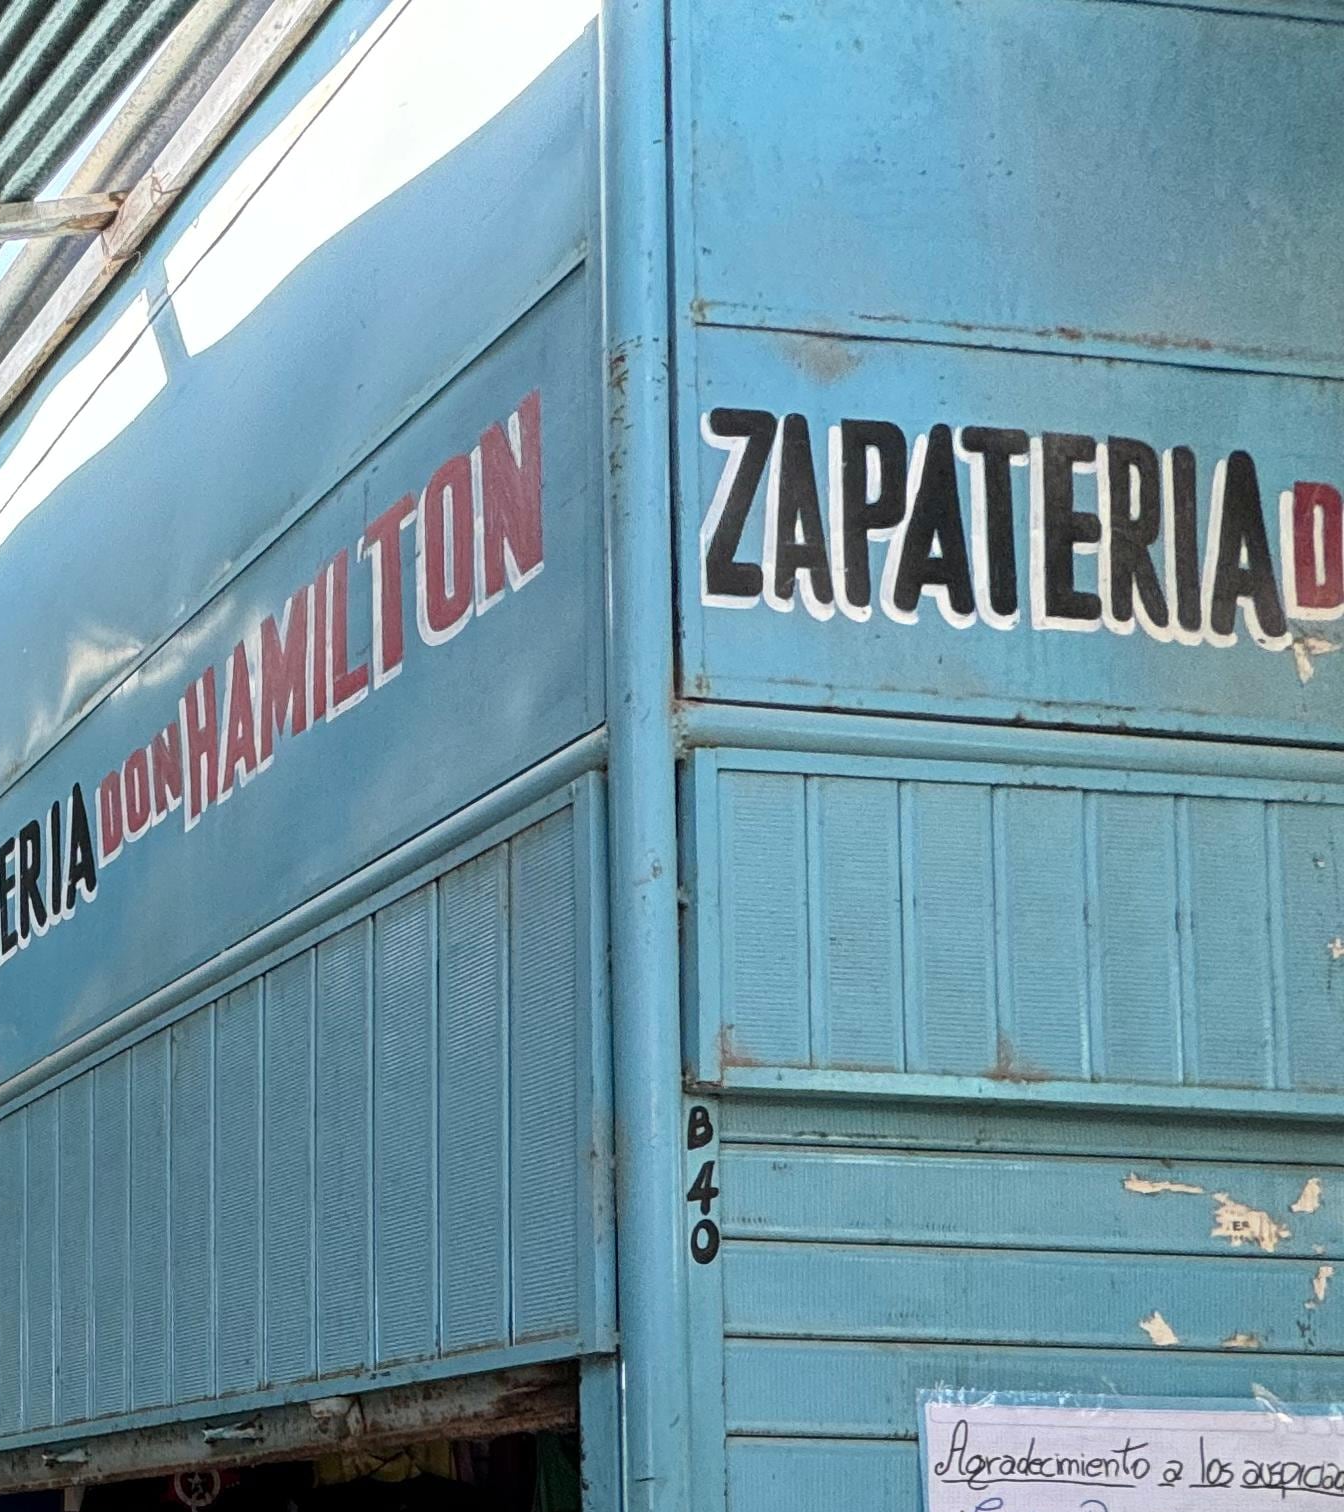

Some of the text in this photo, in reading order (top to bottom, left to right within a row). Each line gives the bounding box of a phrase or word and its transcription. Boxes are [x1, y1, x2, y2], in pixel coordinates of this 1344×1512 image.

[96, 721, 183, 869] DON
[178, 388, 544, 833] HAMILTON
[699, 407, 1292, 650] ZAPATERIA
[934, 1420, 1151, 1490] Agradecimiento
[1162, 1459, 1183, 1482] a
[1199, 1436, 1234, 1484] los
